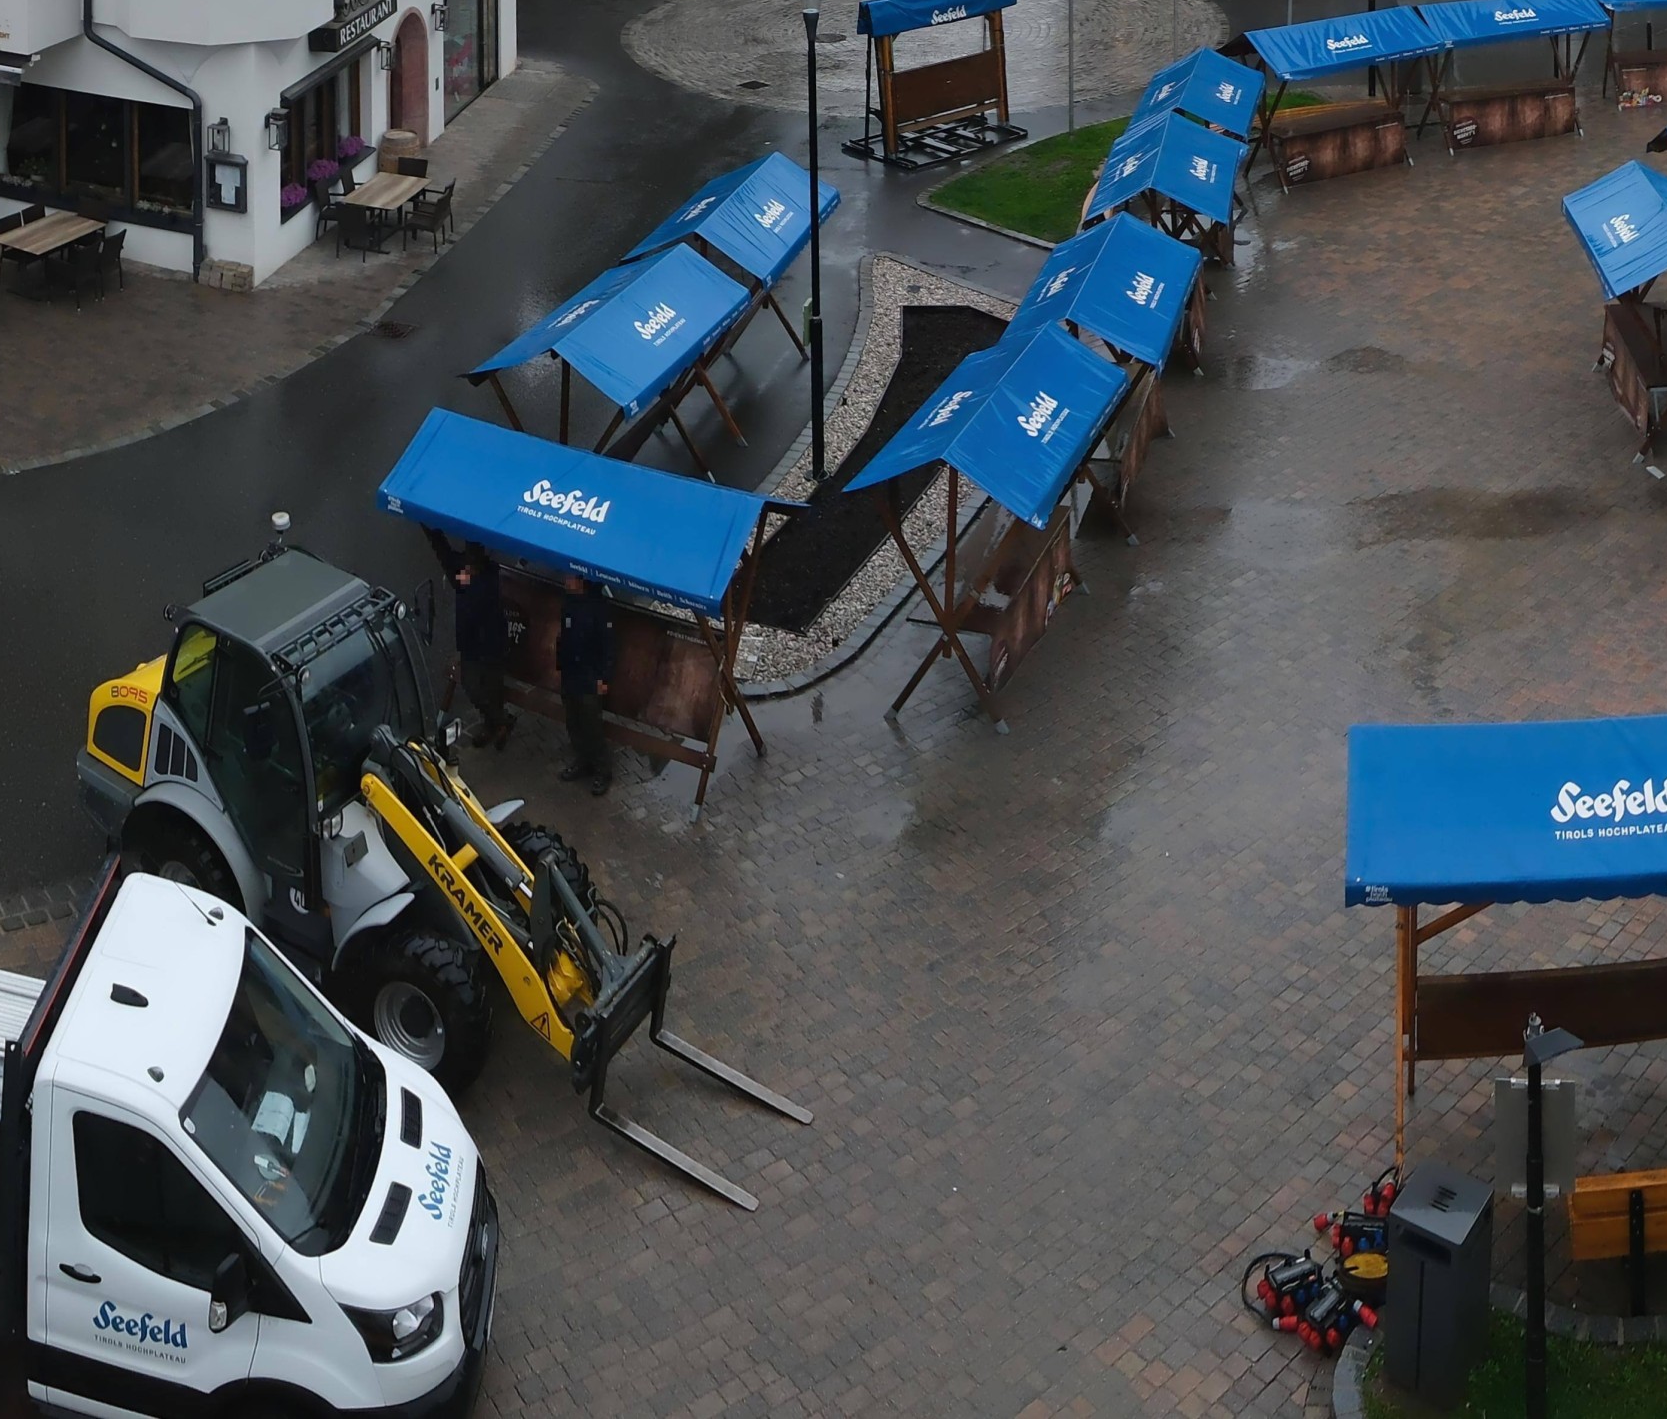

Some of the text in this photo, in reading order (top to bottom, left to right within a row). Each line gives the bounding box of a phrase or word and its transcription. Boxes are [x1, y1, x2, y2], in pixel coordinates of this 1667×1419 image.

[931, 4, 967, 25] Seefeld
[1494, 8, 1537, 21] Seefeld
[1326, 34, 1369, 52] Seefeld
[754, 198, 786, 228] Seefeld
[1609, 214, 1640, 244] Seefeld
[1125, 271, 1155, 305] Seefeld
[633, 302, 677, 340] Seefeld
[1017, 390, 1059, 436] Seefeld
[523, 479, 611, 524] Seefeld
[516, 504, 597, 536] TIROLS HOCHPLATEAU
[110, 685, 148, 705] 8095
[1554, 828, 1594, 841] TIROLS
[428, 852, 503, 956] KRAMER
[418, 1141, 452, 1220] Seefeld
[92, 1300, 188, 1349] Seefeld
[94, 1334, 186, 1364] TIROLS HOCHPLATEAU
